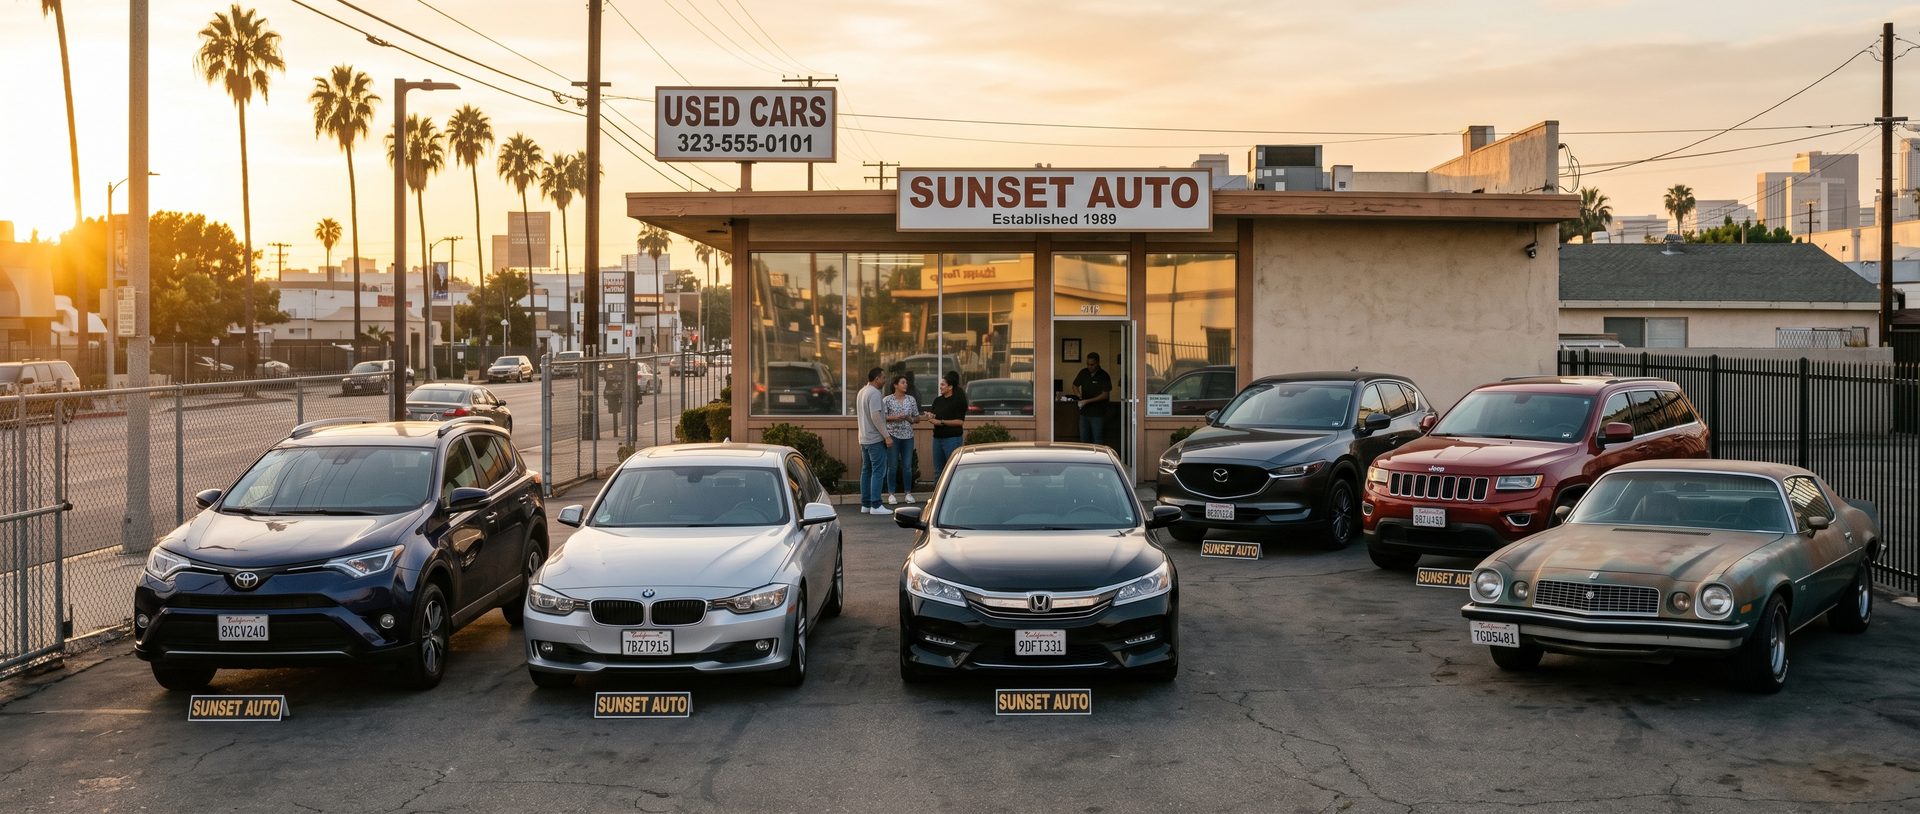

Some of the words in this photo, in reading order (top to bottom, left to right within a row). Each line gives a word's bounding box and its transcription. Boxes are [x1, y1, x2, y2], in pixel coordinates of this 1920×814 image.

[664, 95, 740, 127] USED
[750, 95, 827, 127] CARS
[677, 133, 813, 153] 323-555-0101
[909, 176, 1075, 209] SUNSET
[1086, 176, 1199, 209] AUTO
[992, 213, 1078, 225] Established
[1083, 213, 1117, 225] 1989
[1428, 465, 1445, 473] Jeep
[1203, 543, 1235, 555] SUNSET
[1235, 545, 1258, 557] AUTO
[1419, 571, 1454, 584] SUNSET
[1455, 573, 1473, 586] AUT
[221, 625, 266, 638] 8XCV240
[1473, 630, 1516, 645] 7GD5481
[625, 640, 669, 653] 7BZT915
[1018, 640, 1063, 652] 9DFT331
[192, 699, 243, 717] SUNSET
[244, 699, 280, 717] AUTO
[598, 696, 649, 713] SUNSET
[651, 696, 687, 713] AUTO
[999, 693, 1050, 710] SUNSET
[1053, 693, 1089, 710] AUTO
